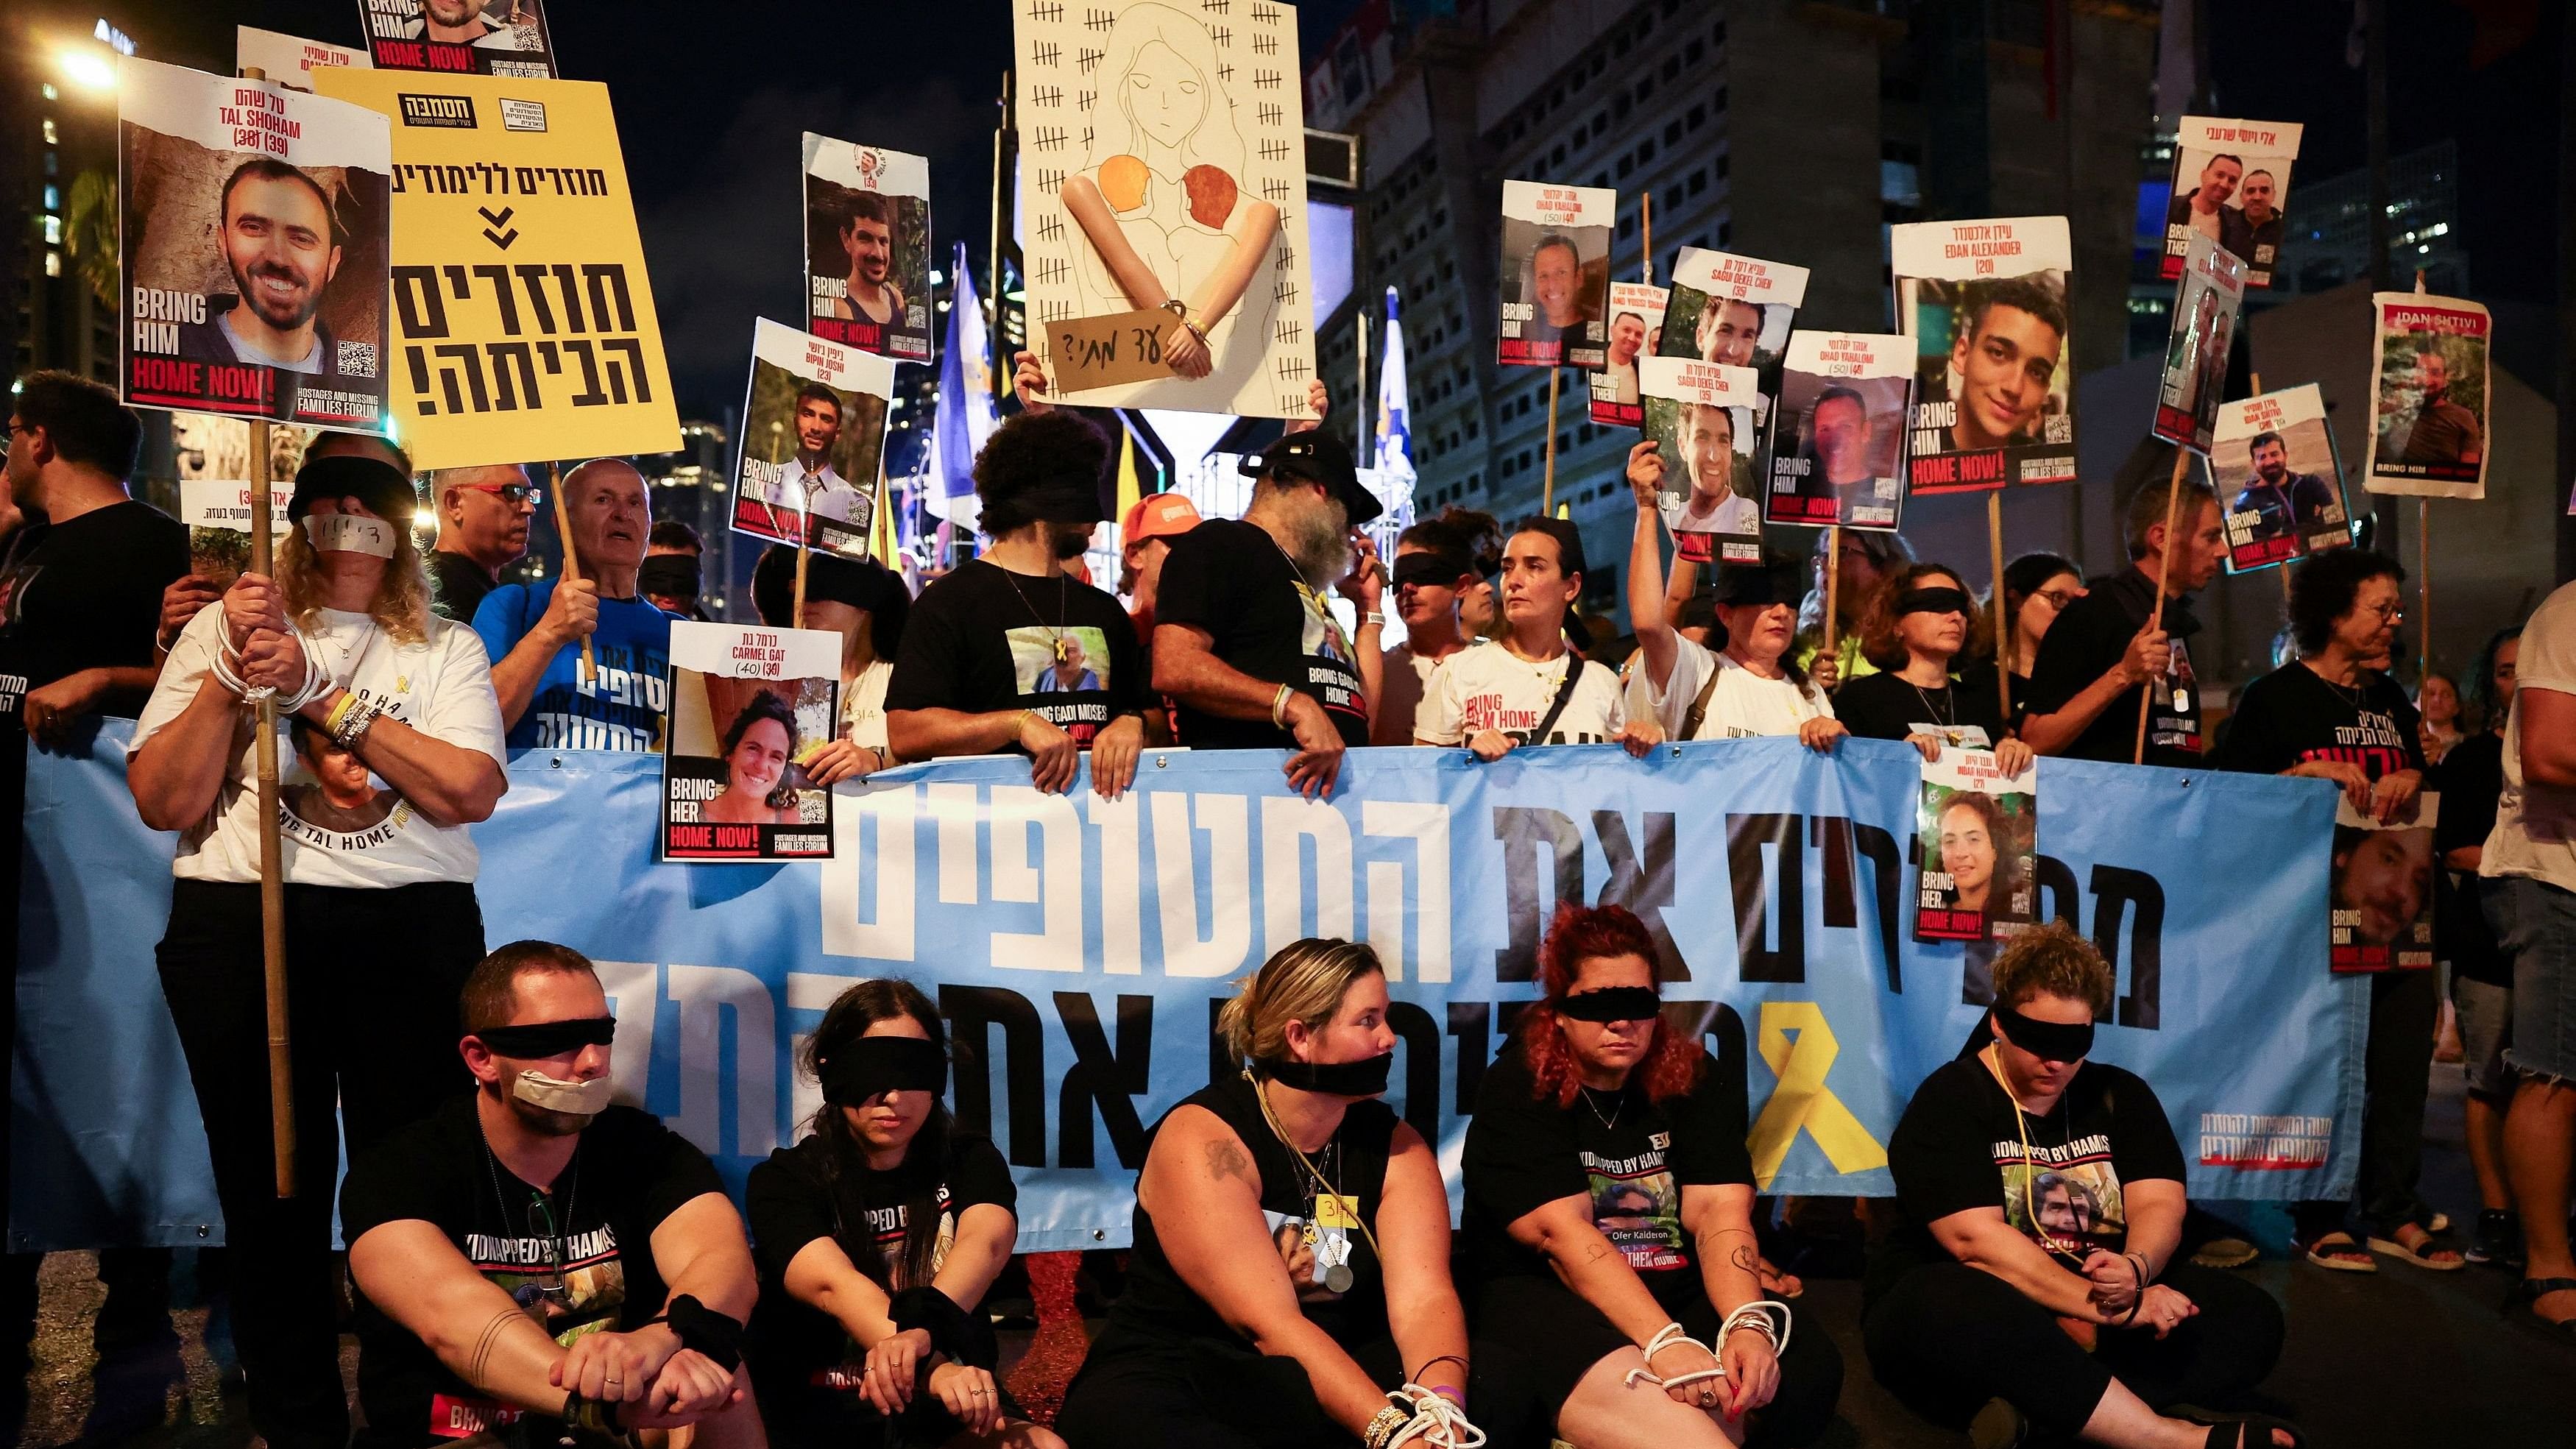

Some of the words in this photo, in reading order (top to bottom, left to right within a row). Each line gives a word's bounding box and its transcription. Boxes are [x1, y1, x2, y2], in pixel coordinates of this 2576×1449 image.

[372, 15, 406, 39] HIM
[376, 41, 426, 68] HOME
[428, 45, 476, 71] NOW!
[235, 89, 265, 108] שהם
[269, 93, 284, 114] טל
[405, 96, 470, 118] חסמבה
[219, 107, 243, 126] TAL
[247, 110, 300, 139] SHOHAM
[264, 132, 288, 157] (39)
[2261, 132, 2276, 146] אלי
[515, 166, 609, 196] חוזרים
[1544, 213, 1562, 223] (50)
[1992, 224, 2011, 240] עידן
[1945, 242, 1970, 258] EDAN
[1972, 241, 2022, 258] ALEXANDER
[1975, 259, 1994, 275] (20)
[813, 275, 847, 298] BRING
[1711, 269, 1733, 282] SAGUI
[1734, 274, 1754, 286] DEKEL
[1755, 277, 1772, 289] CHEN
[391, 264, 637, 339] חוזרים
[1733, 286, 1747, 298] (35)
[133, 287, 206, 325] BRING
[813, 297, 835, 318] HIM
[1502, 302, 1533, 321] BRING
[1502, 321, 1521, 338] HIM
[2396, 311, 2430, 324] IDAN
[2435, 314, 2477, 329] SHTIVI
[133, 322, 179, 355] HIM
[813, 319, 845, 341] HOME
[848, 322, 880, 344] NOW!
[1133, 324, 1161, 365] עד
[1502, 340, 1529, 357] HOME
[806, 353, 824, 366] BIPIN
[825, 359, 844, 373] JOSHI
[1820, 351, 1839, 361] OHAD
[405, 338, 653, 416] הביתה!
[817, 368, 832, 383] (23)
[1828, 364, 1848, 374] (50)
[133, 358, 201, 394] HOME
[208, 365, 275, 402] NOW!
[1590, 372, 1618, 389] BRING
[1678, 375, 1696, 387] SAGUI
[1697, 377, 1715, 389] DEKEL
[1716, 380, 1729, 392] CHEN
[297, 388, 333, 402] HOSTAGES
[333, 393, 347, 403] AND
[349, 394, 378, 405] MISSING
[1591, 386, 1618, 403] THEM
[1699, 390, 1711, 402] (35)
[297, 398, 342, 416] FAMILIES
[344, 402, 378, 419] FORUM
[1592, 401, 1618, 417] HOME
[1911, 401, 1957, 430] BRING
[1911, 428, 1941, 456] HIM
[743, 456, 783, 485] BRING
[1775, 457, 1811, 476] BRING
[1911, 455, 1956, 485] HOME
[1960, 450, 2006, 481] NOW!
[2376, 463, 2406, 472] BRING
[2408, 465, 2427, 474] HIM
[740, 478, 766, 502] HIM
[1774, 475, 1796, 494] HIM
[204, 508, 228, 519] בעזה.
[2227, 509, 2262, 531] BRING
[1682, 534, 1712, 553] NOW!
[2231, 527, 2254, 547] HIM
[742, 633, 754, 646] גת
[756, 634, 777, 647] כרמל
[732, 646, 767, 661] CARMEL
[768, 649, 786, 662] GAT
[735, 662, 760, 675] (40)
[1309, 667, 1337, 684] BRING
[1326, 686, 1350, 706] HOME
[854, 709, 877, 721] 314
[1055, 705, 1076, 722] GADI
[1078, 704, 1107, 721] MOSES
[1499, 710, 1537, 728] HOME
[2335, 726, 2377, 745] הביתה
[1958, 765, 1975, 777] INBAR
[1976, 767, 2000, 779] HAYMAN
[670, 778, 717, 801] BRING
[670, 801, 699, 823] HER
[305, 827, 333, 849] TAL
[342, 824, 394, 851] HOME
[670, 826, 713, 848] HOME
[716, 824, 759, 849] NOW!
[774, 834, 798, 843] HOSTAGES
[774, 840, 804, 853] FAMILIES
[804, 841, 829, 853] FORUM
[819, 782, 1451, 984] החטופים
[1922, 871, 1955, 890] BRING
[1494, 807, 1693, 984] את
[1922, 890, 1942, 908] HER
[1919, 911, 1950, 929] HOME
[1952, 912, 1983, 932] NOW!
[2333, 910, 2361, 927] BRING
[2333, 927, 2351, 944] HIM
[938, 984, 1153, 1169] את
[2050, 1144, 2070, 1162] BY
[2070, 1134, 2111, 1158] HAMAS
[1624, 1158, 1638, 1173] BY
[1613, 1231, 1631, 1240] Ofer
[1634, 1230, 1668, 1239] Kalderon
